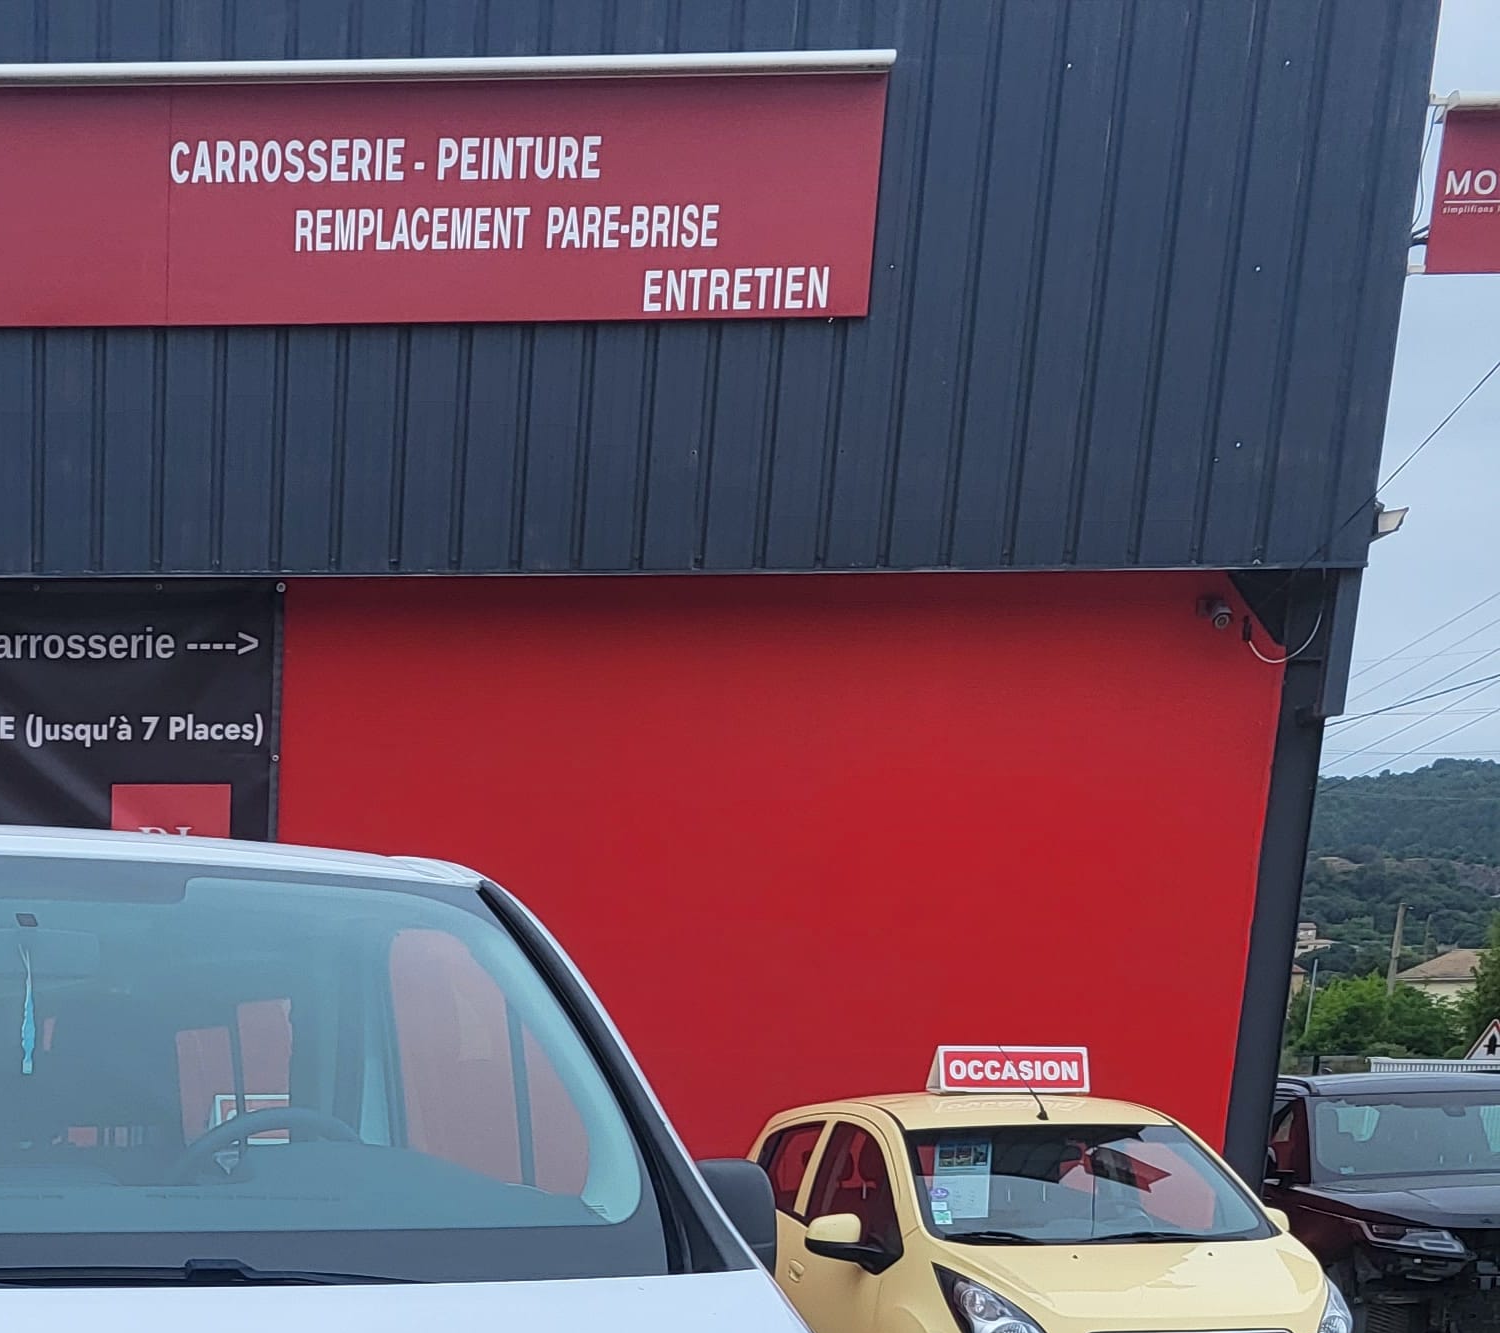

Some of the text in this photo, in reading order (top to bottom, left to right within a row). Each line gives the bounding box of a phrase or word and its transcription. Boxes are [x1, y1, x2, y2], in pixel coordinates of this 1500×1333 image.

[170, 138, 405, 184] CARROSSERIE
[437, 136, 602, 181] PEINTURE
[295, 205, 720, 251] REMPLACEMENT PARE-BRISE
[642, 266, 830, 312] ENTRETIEN
[25, 713, 133, 748] (Jusqu'à
[141, 716, 161, 741] 7
[168, 713, 264, 746] Places)
[949, 1059, 1079, 1081] OCCASION
